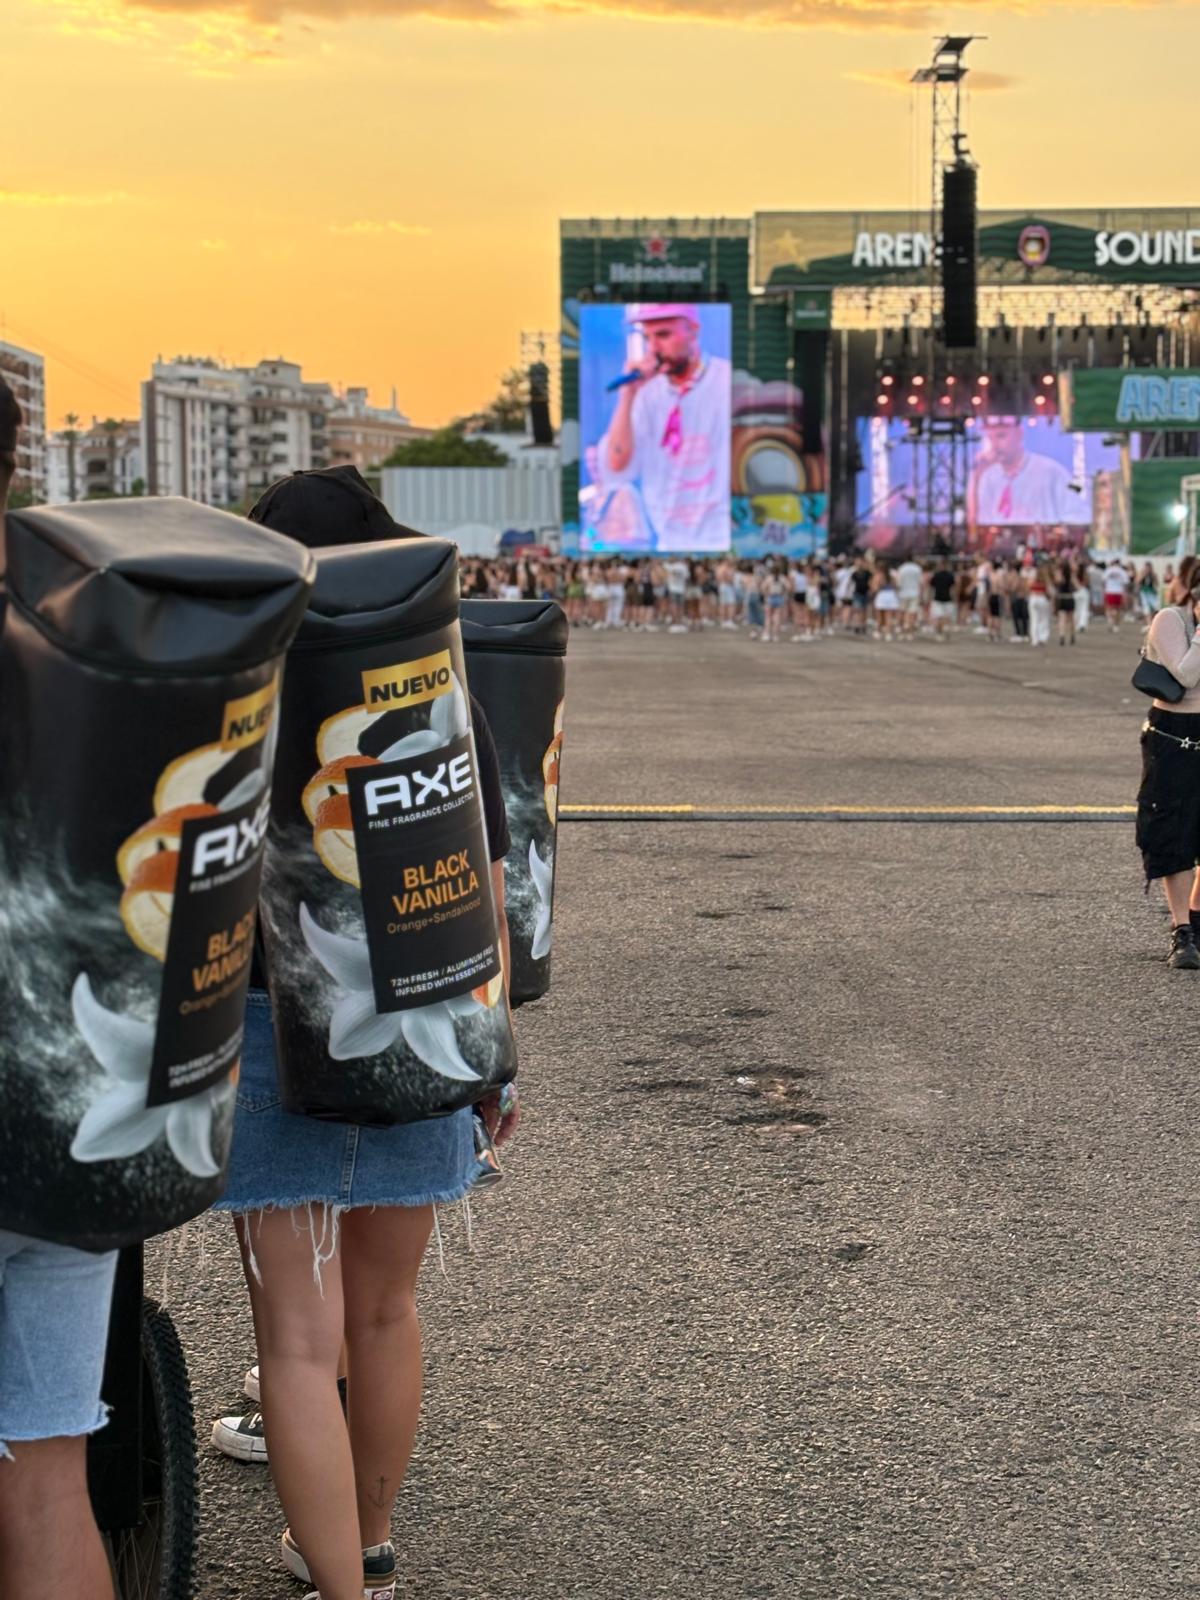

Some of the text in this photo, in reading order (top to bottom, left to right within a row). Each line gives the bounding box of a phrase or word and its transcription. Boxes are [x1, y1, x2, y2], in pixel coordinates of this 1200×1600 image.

[852, 231, 942, 267] AREN
[370, 667, 450, 703] NUEVO
[364, 751, 472, 816] AXE
[368, 819, 390, 829] FINE
[392, 805, 442, 824] FRAGRANCE
[403, 849, 470, 889] BLACK
[392, 871, 479, 915] VANILLA
[207, 909, 254, 960] BLAC
[391, 978, 409, 987] 72H
[411, 970, 439, 983] FRESH
[395, 982, 433, 997] INFUSED
[434, 976, 454, 988] WITH
[455, 962, 486, 981] ESSENTIAL
